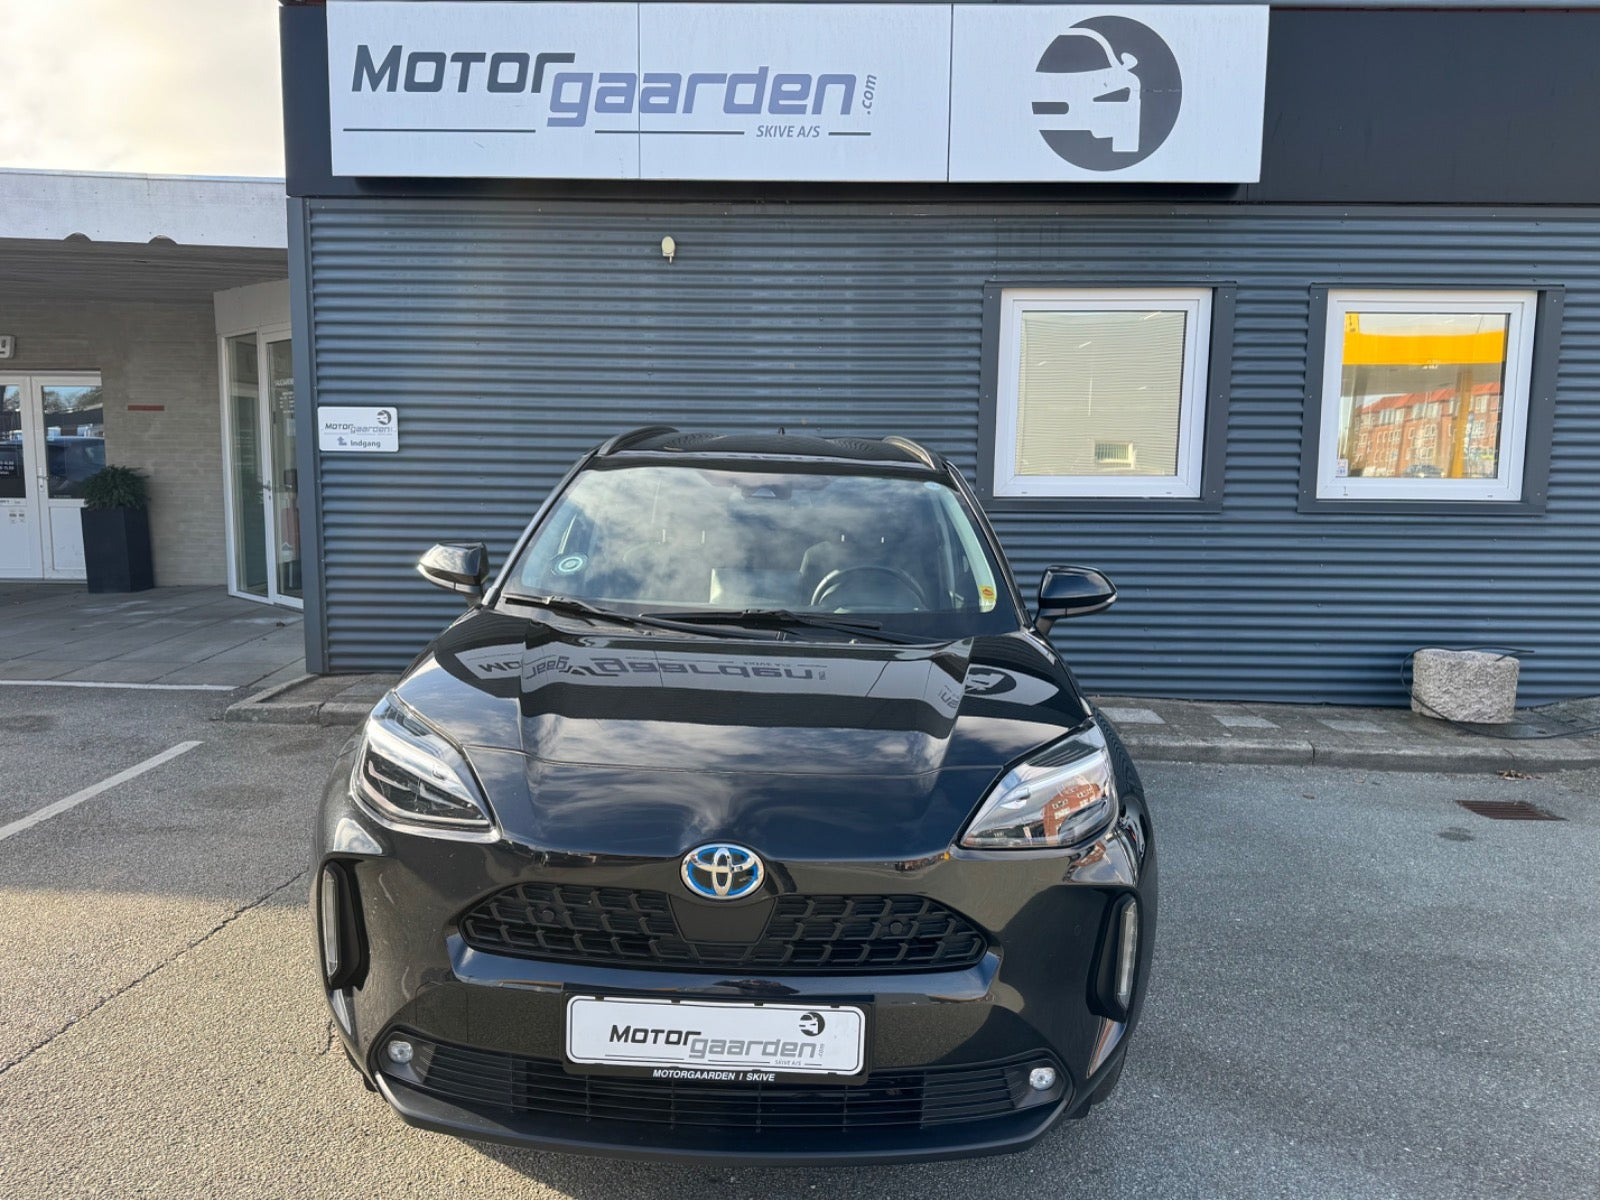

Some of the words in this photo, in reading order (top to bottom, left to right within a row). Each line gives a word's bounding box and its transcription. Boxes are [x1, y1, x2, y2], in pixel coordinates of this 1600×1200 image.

[756, 125, 795, 138] SKIVE
[796, 125, 821, 138] A/S
[350, 439, 381, 448] Indgang
[652, 1069, 736, 1081] MOTORGAARDEN
[746, 1072, 776, 1082] SKIVE
